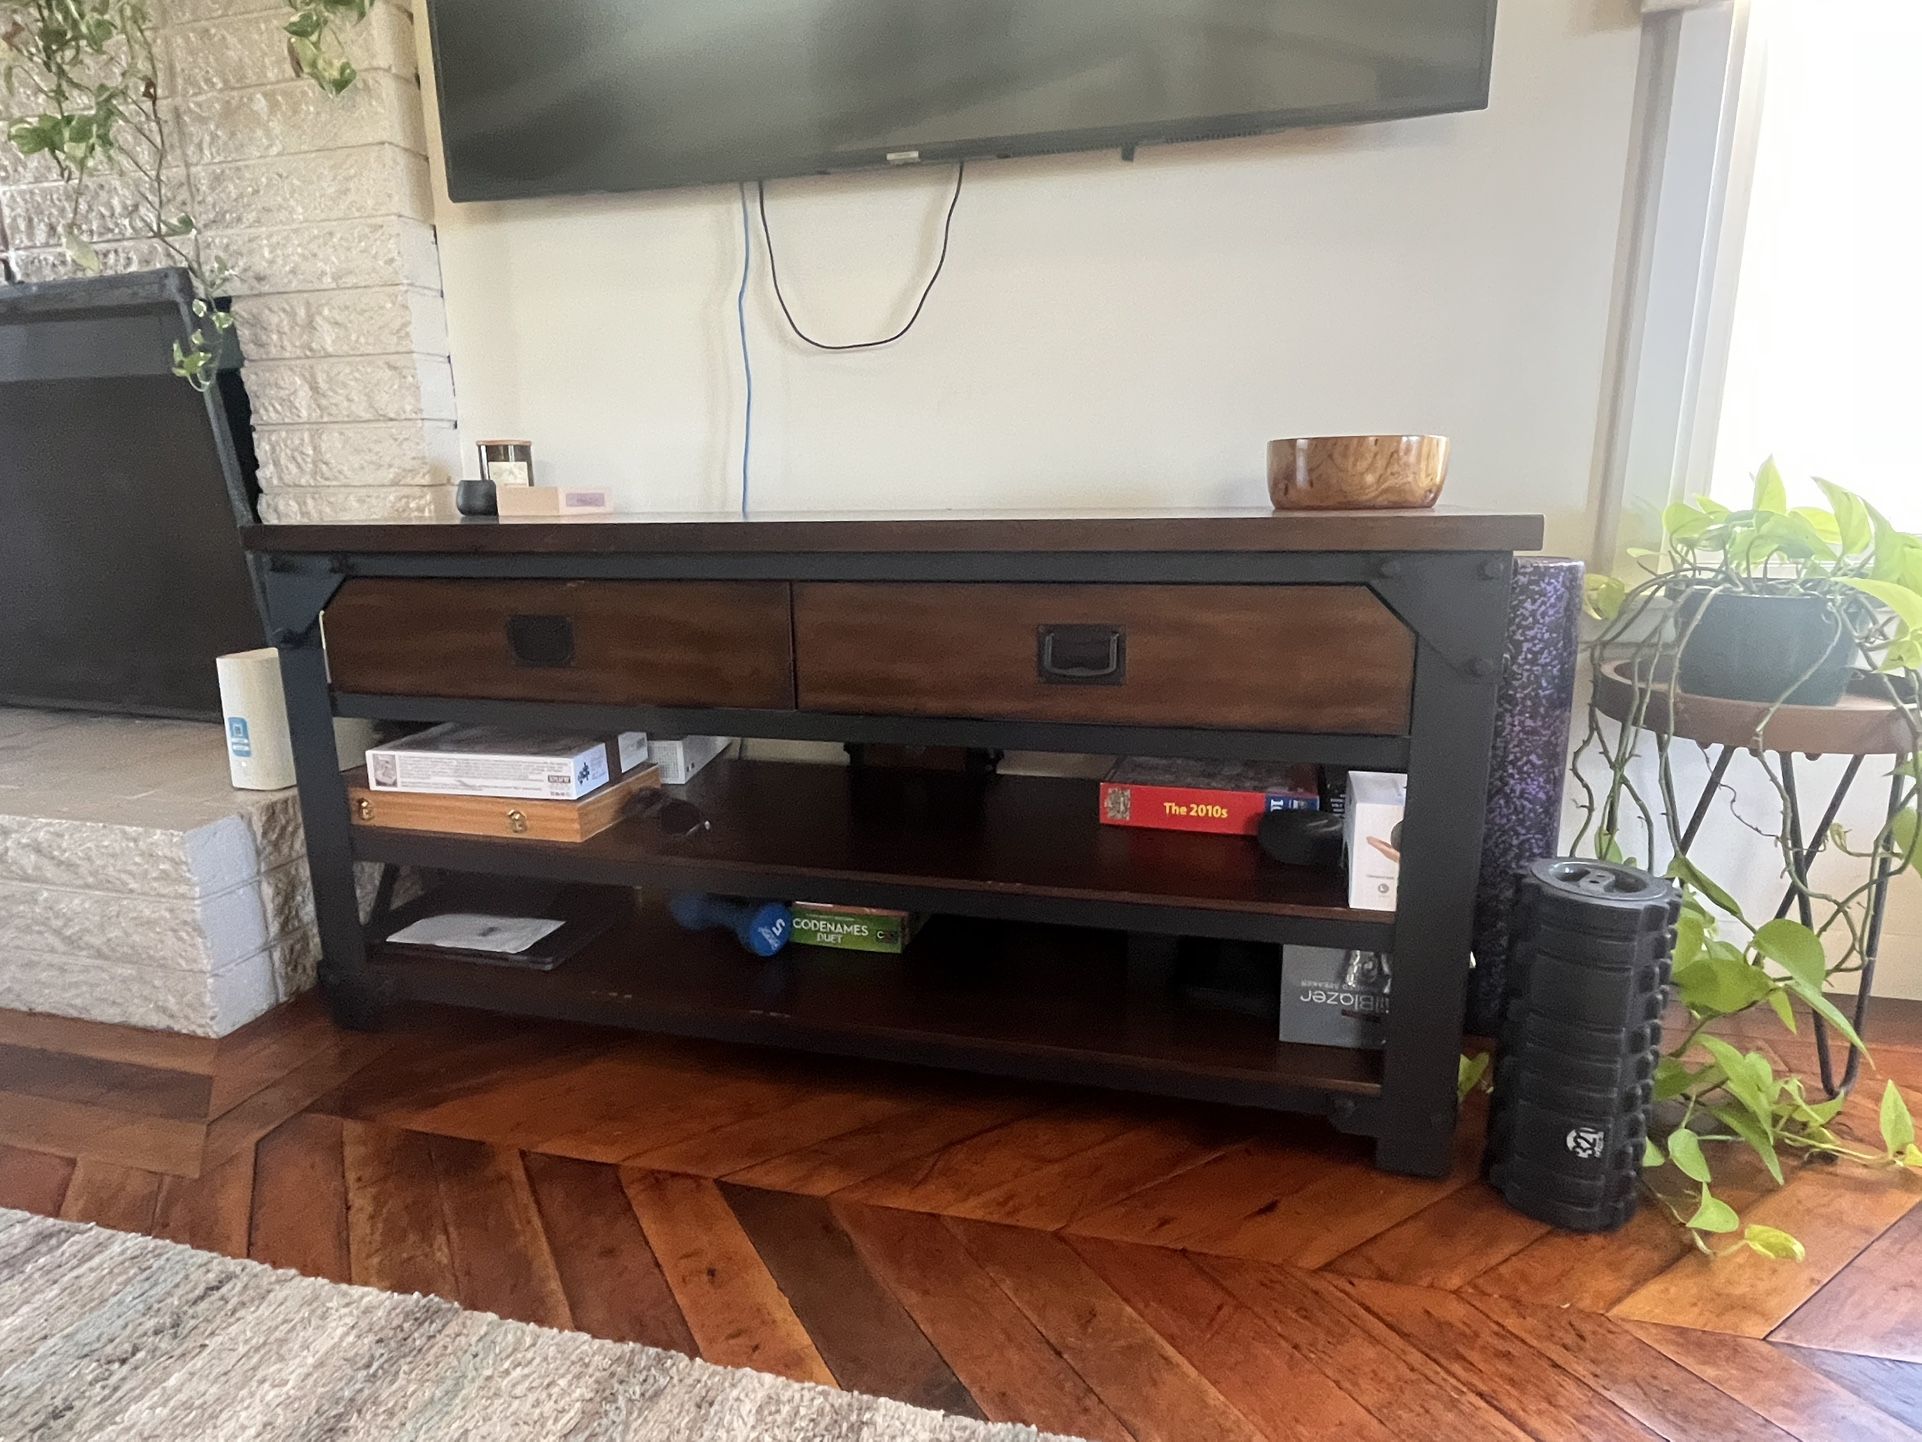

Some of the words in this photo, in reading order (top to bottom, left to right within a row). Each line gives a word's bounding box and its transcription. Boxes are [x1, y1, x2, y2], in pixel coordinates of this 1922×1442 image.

[1163, 802, 1187, 815] The
[1189, 803, 1228, 818] 2010s
[792, 917, 869, 936] CODENAMES
[817, 933, 843, 943] DUET
